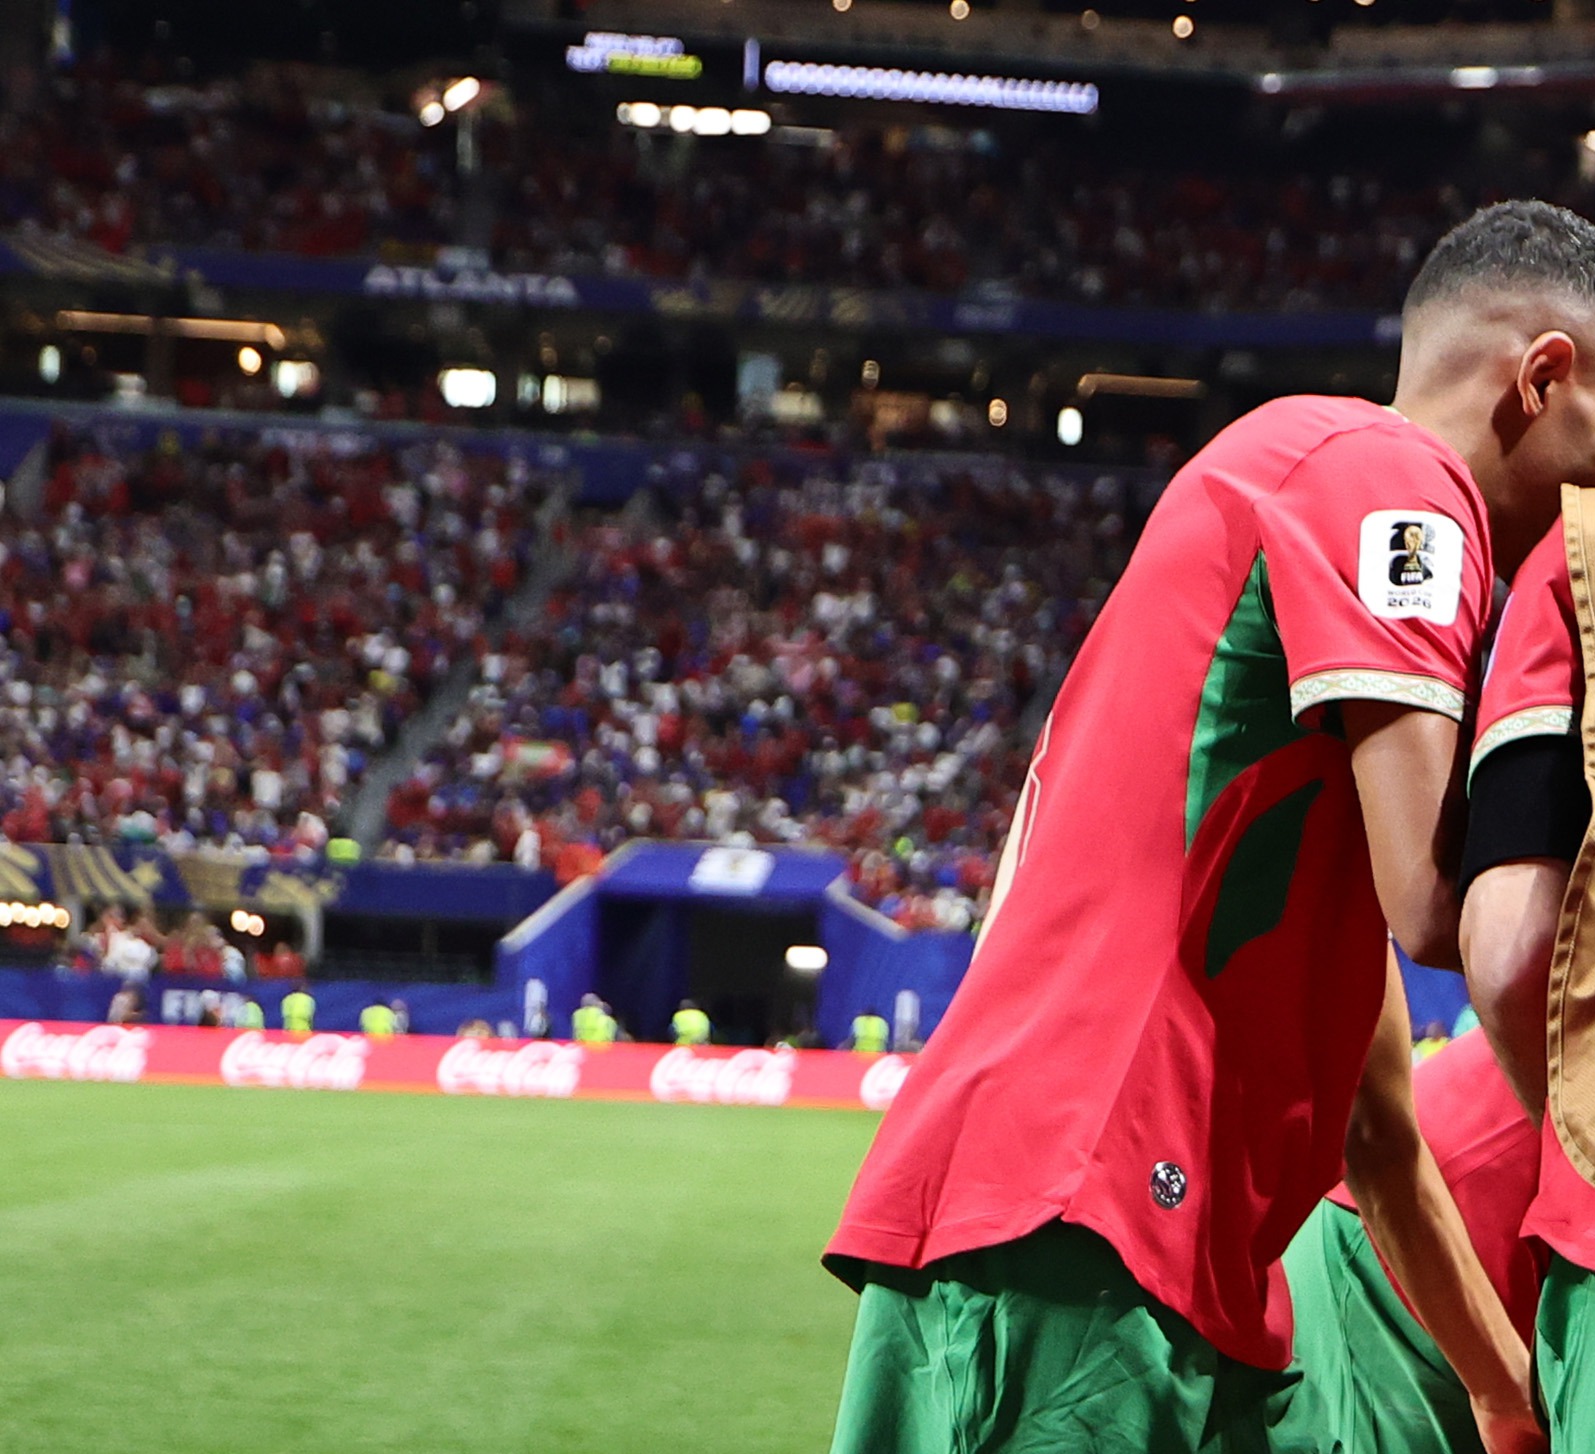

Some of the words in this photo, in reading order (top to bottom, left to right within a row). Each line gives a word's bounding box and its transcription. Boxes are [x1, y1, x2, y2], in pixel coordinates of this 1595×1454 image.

[364, 264, 580, 304] ATLANTA
[1387, 597, 1432, 609] 2026
[219, 1030, 370, 1090] Coca-Cola
[436, 1038, 585, 1097] Coca-Cola
[650, 1046, 797, 1105] Coca-Cola
